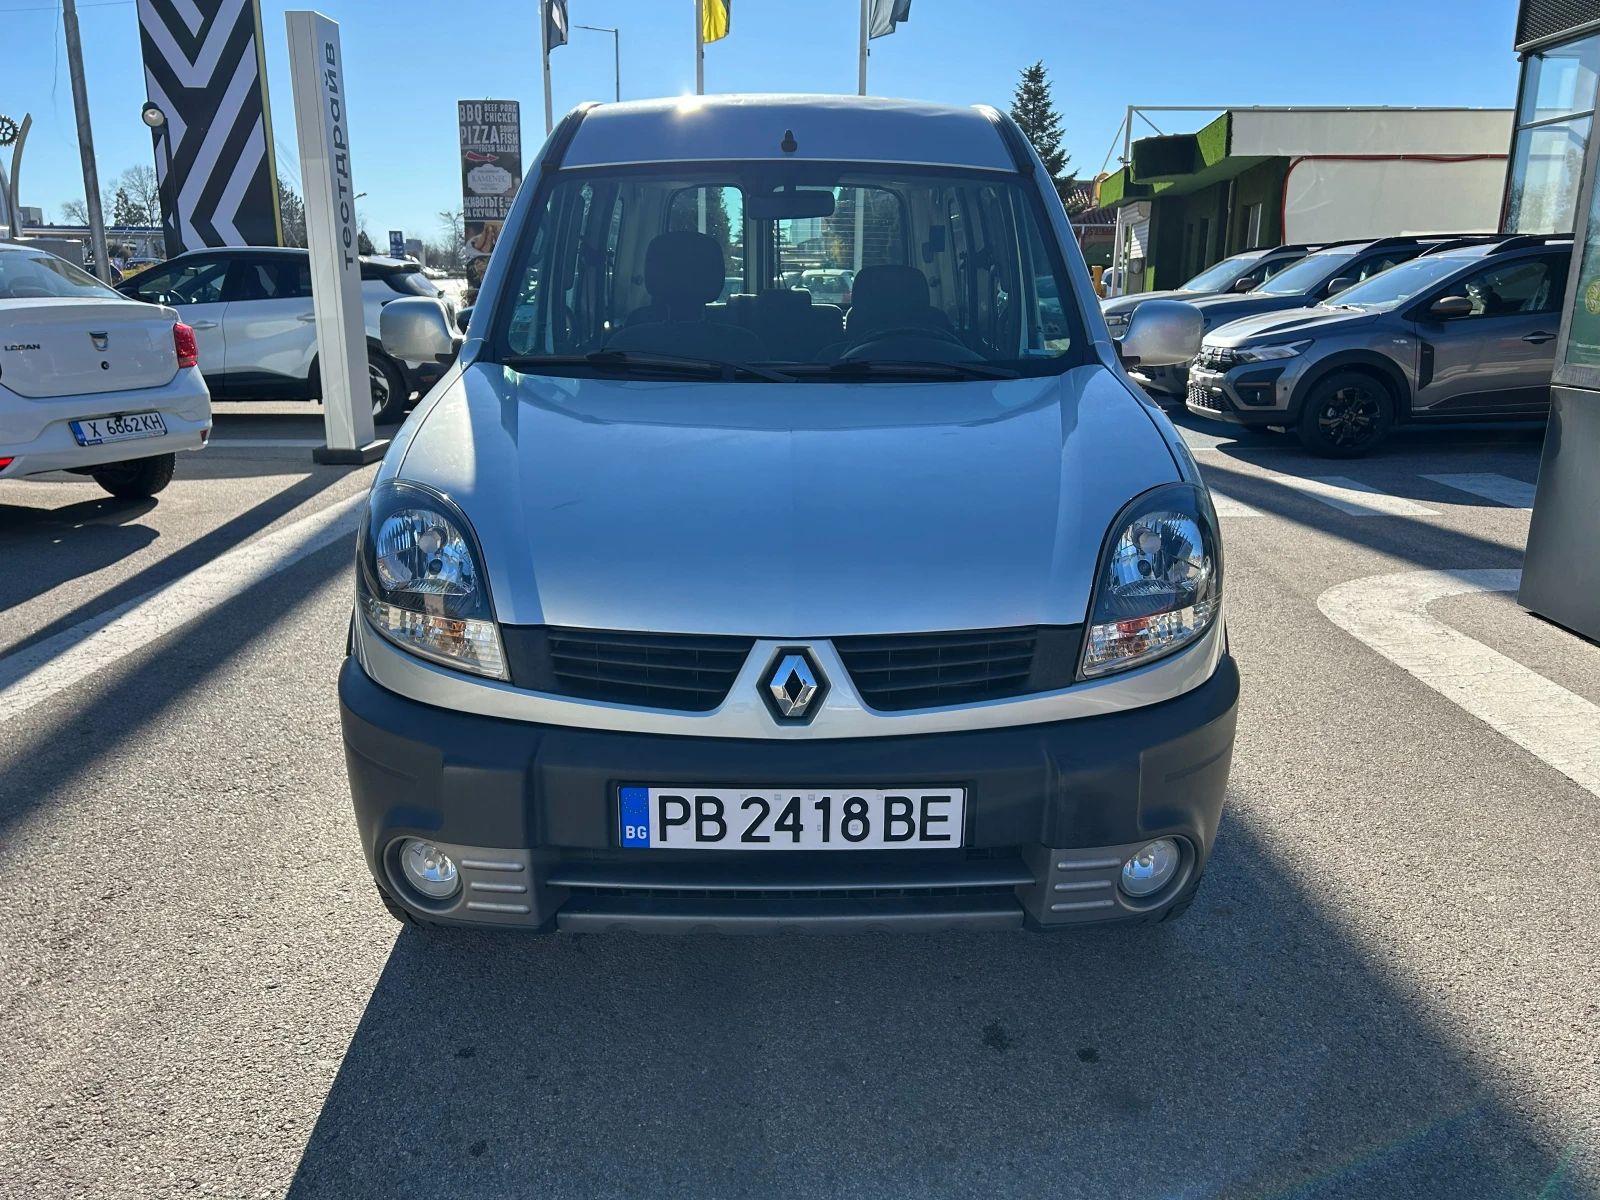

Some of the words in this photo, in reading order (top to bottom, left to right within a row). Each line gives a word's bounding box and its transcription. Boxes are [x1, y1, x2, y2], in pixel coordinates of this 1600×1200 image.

[484, 104, 498, 112] BEEF
[500, 104, 517, 112] PORK
[459, 104, 482, 124] BBQ
[484, 112, 517, 122] CHICKEN
[460, 125, 500, 144] PIZZA
[500, 133, 518, 144] FISH
[479, 144, 495, 152] FRESH
[496, 144, 518, 152] SALADS
[325, 41, 354, 270] тестдрайв
[471, 174, 508, 183] KAMENEC
[472, 208, 498, 218] СКУЧНА
[4, 343, 41, 351] LOGAN
[625, 825, 647, 839] BG
[658, 795, 727, 842] PB
[740, 796, 870, 842] 2418
[883, 796, 951, 842] BE
